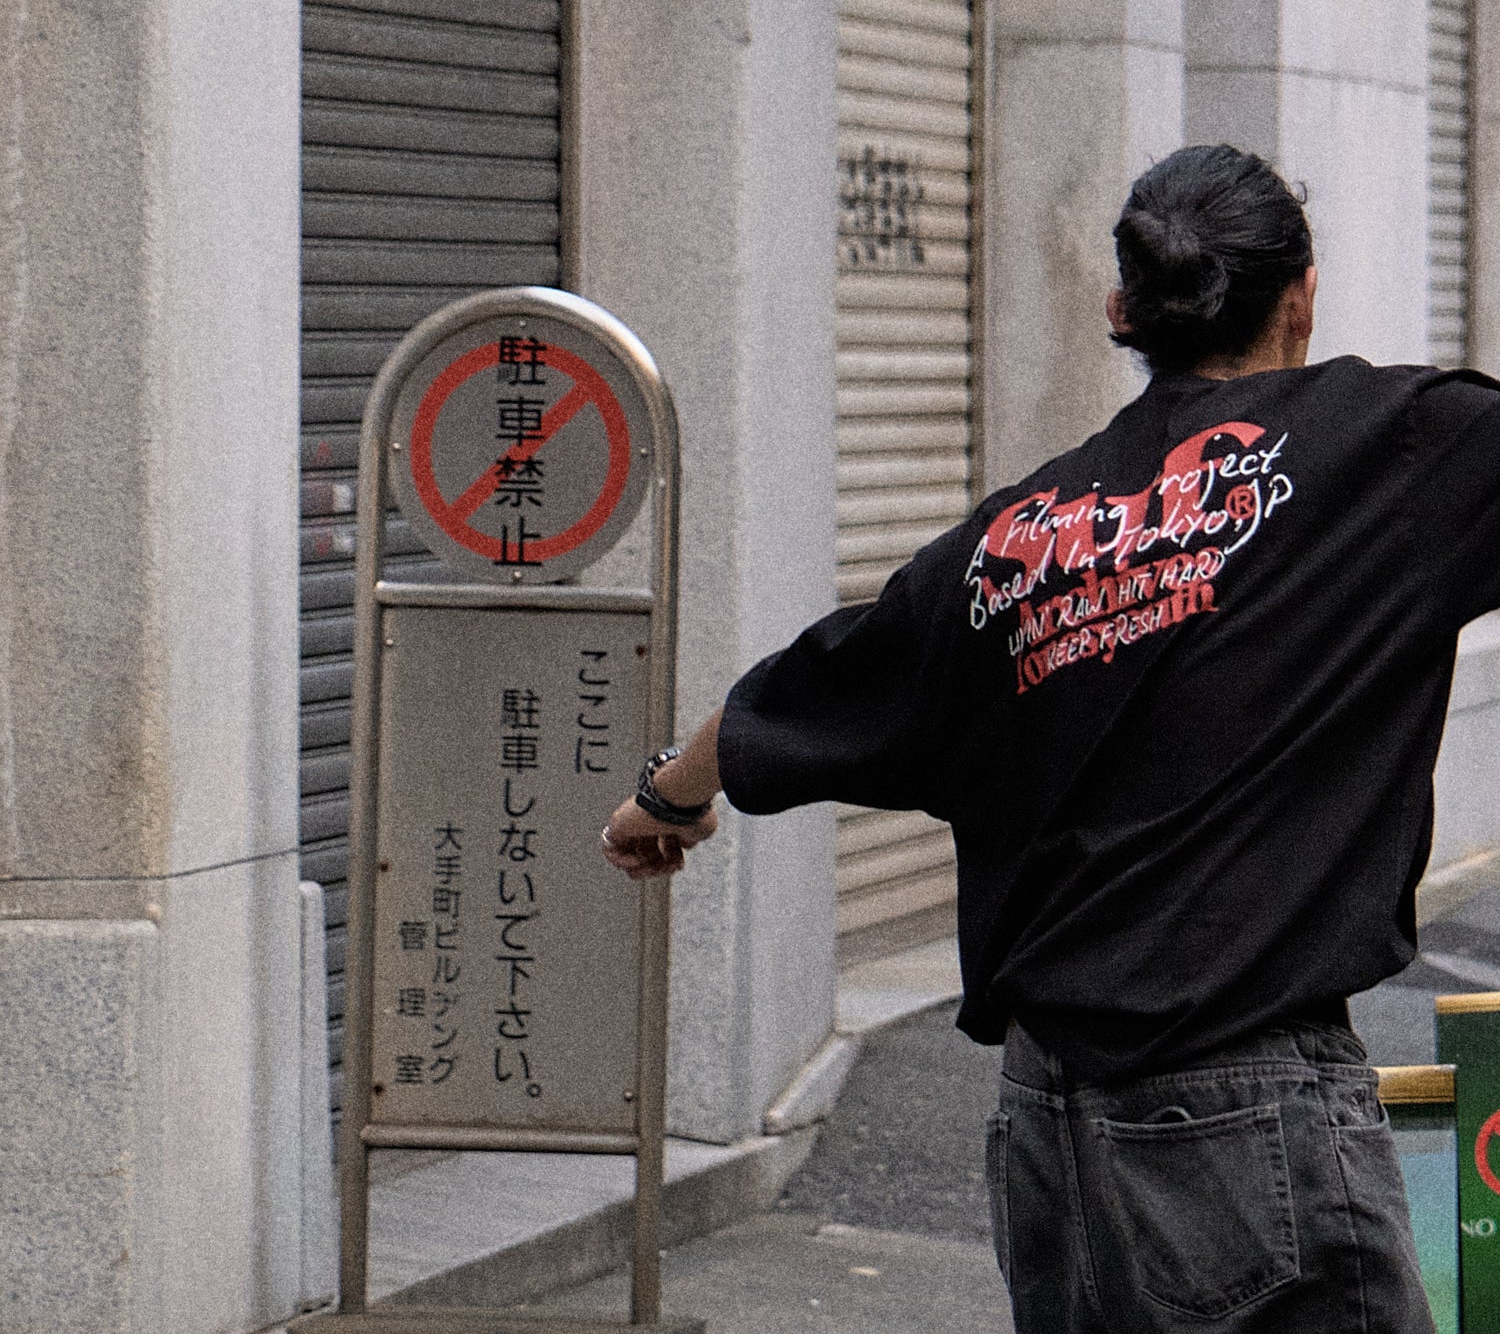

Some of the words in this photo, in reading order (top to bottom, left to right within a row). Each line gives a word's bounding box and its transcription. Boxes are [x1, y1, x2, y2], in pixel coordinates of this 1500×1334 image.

[493, 335, 548, 568] 駐車禁止
[998, 480, 1130, 555] Filming
[1157, 431, 1289, 513] roject
[968, 532, 1060, 630] Based
[1056, 585, 1106, 628] RAW
[1118, 572, 1152, 605] HIT
[1159, 550, 1226, 589] HARD
[1099, 603, 1164, 651] FRESH
[574, 649, 610, 774] ここに
[493, 689, 543, 1100] 駐車しないで下さい。
[394, 921, 428, 1086] 管理室
[1461, 1217, 1496, 1237] NO
